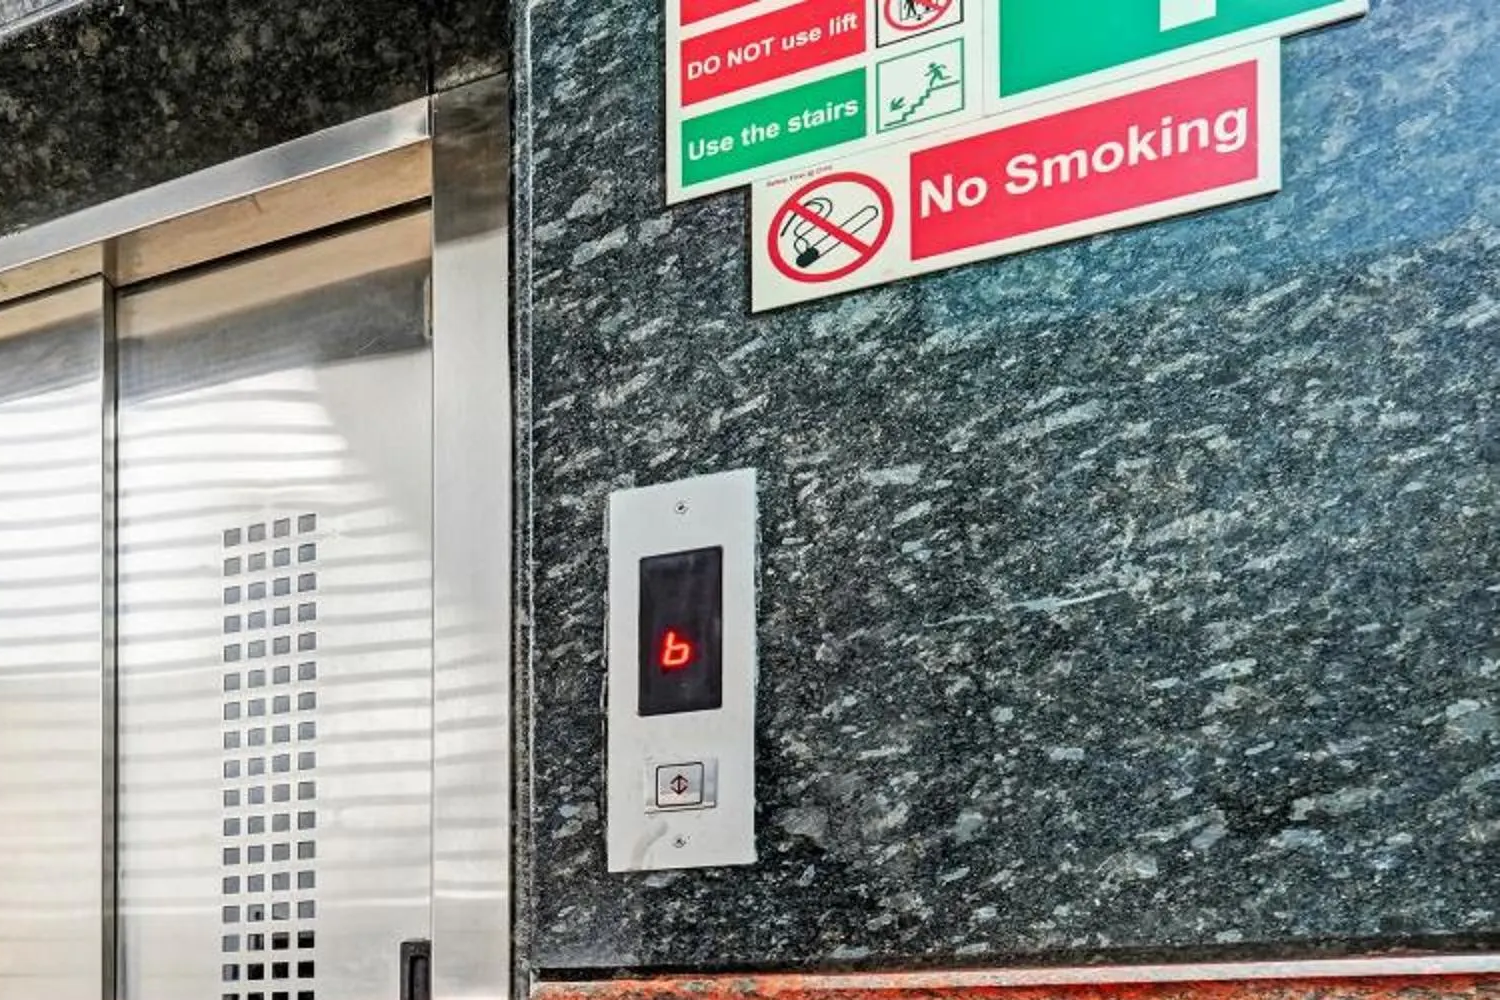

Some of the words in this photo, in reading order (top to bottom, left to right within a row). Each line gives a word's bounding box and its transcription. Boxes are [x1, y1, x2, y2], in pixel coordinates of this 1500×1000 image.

[687, 57, 721, 81] DO
[727, 37, 775, 68] NOT
[781, 27, 822, 51] use
[828, 12, 859, 36] lift
[688, 135, 735, 161] Use
[741, 122, 780, 147] the
[787, 99, 859, 133] stairs
[919, 173, 988, 219] No
[1005, 106, 1248, 195] Smoking
